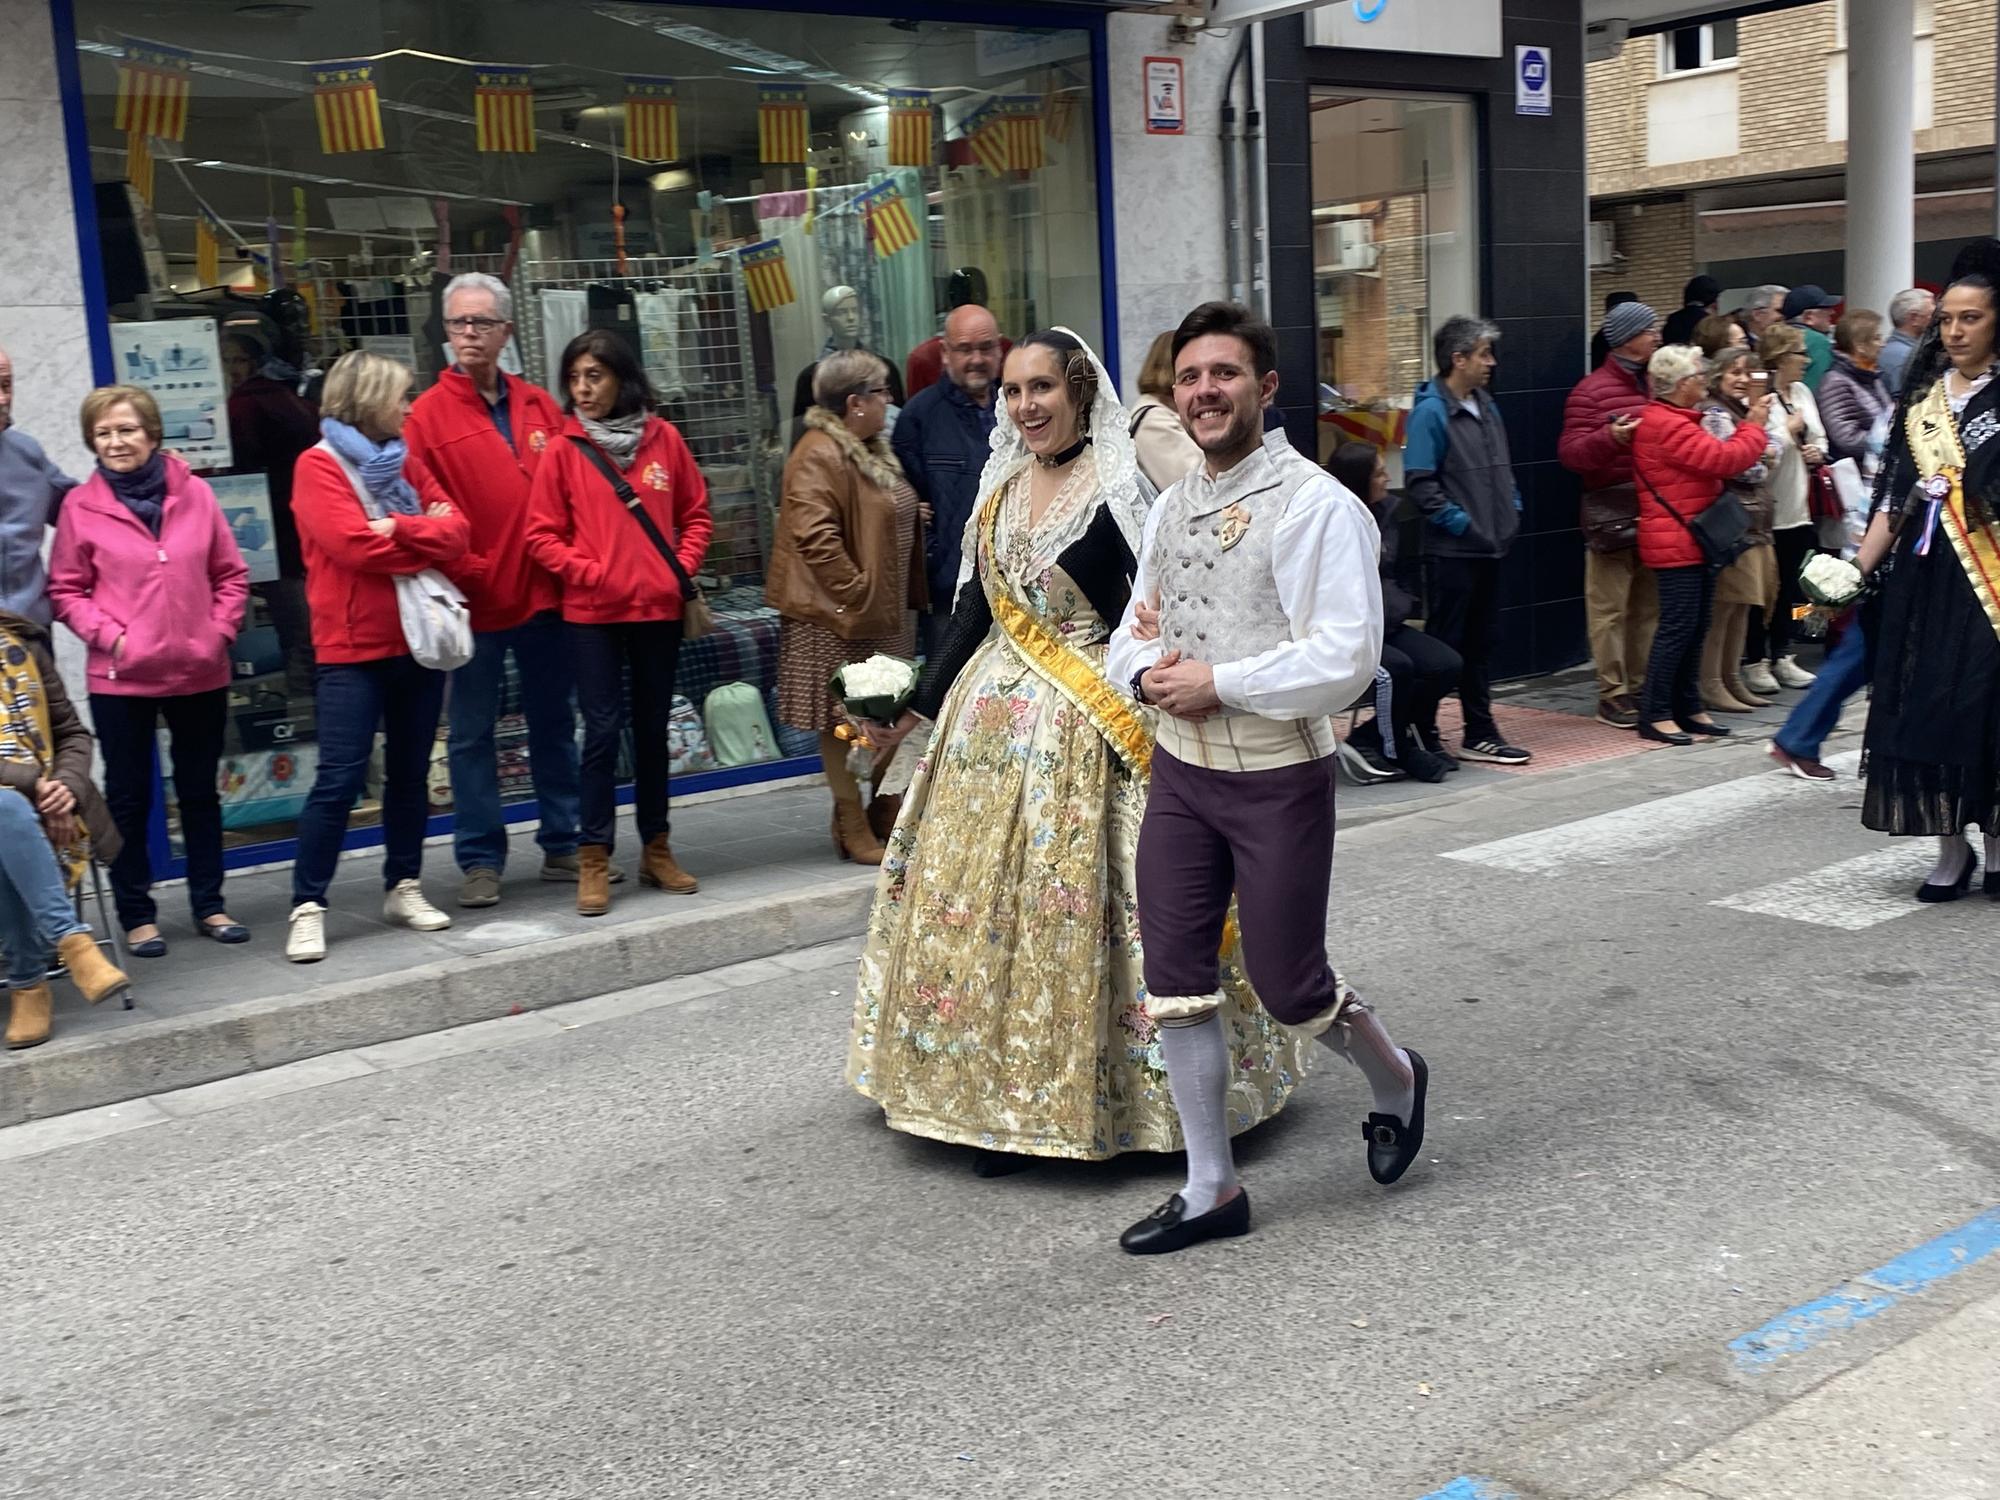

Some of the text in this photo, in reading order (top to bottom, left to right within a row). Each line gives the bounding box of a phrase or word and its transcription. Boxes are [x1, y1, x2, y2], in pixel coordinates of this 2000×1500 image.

[1524, 63, 1544, 77] ADT
[1083, 681, 1114, 711] DE
[1110, 707, 1136, 741] LA
